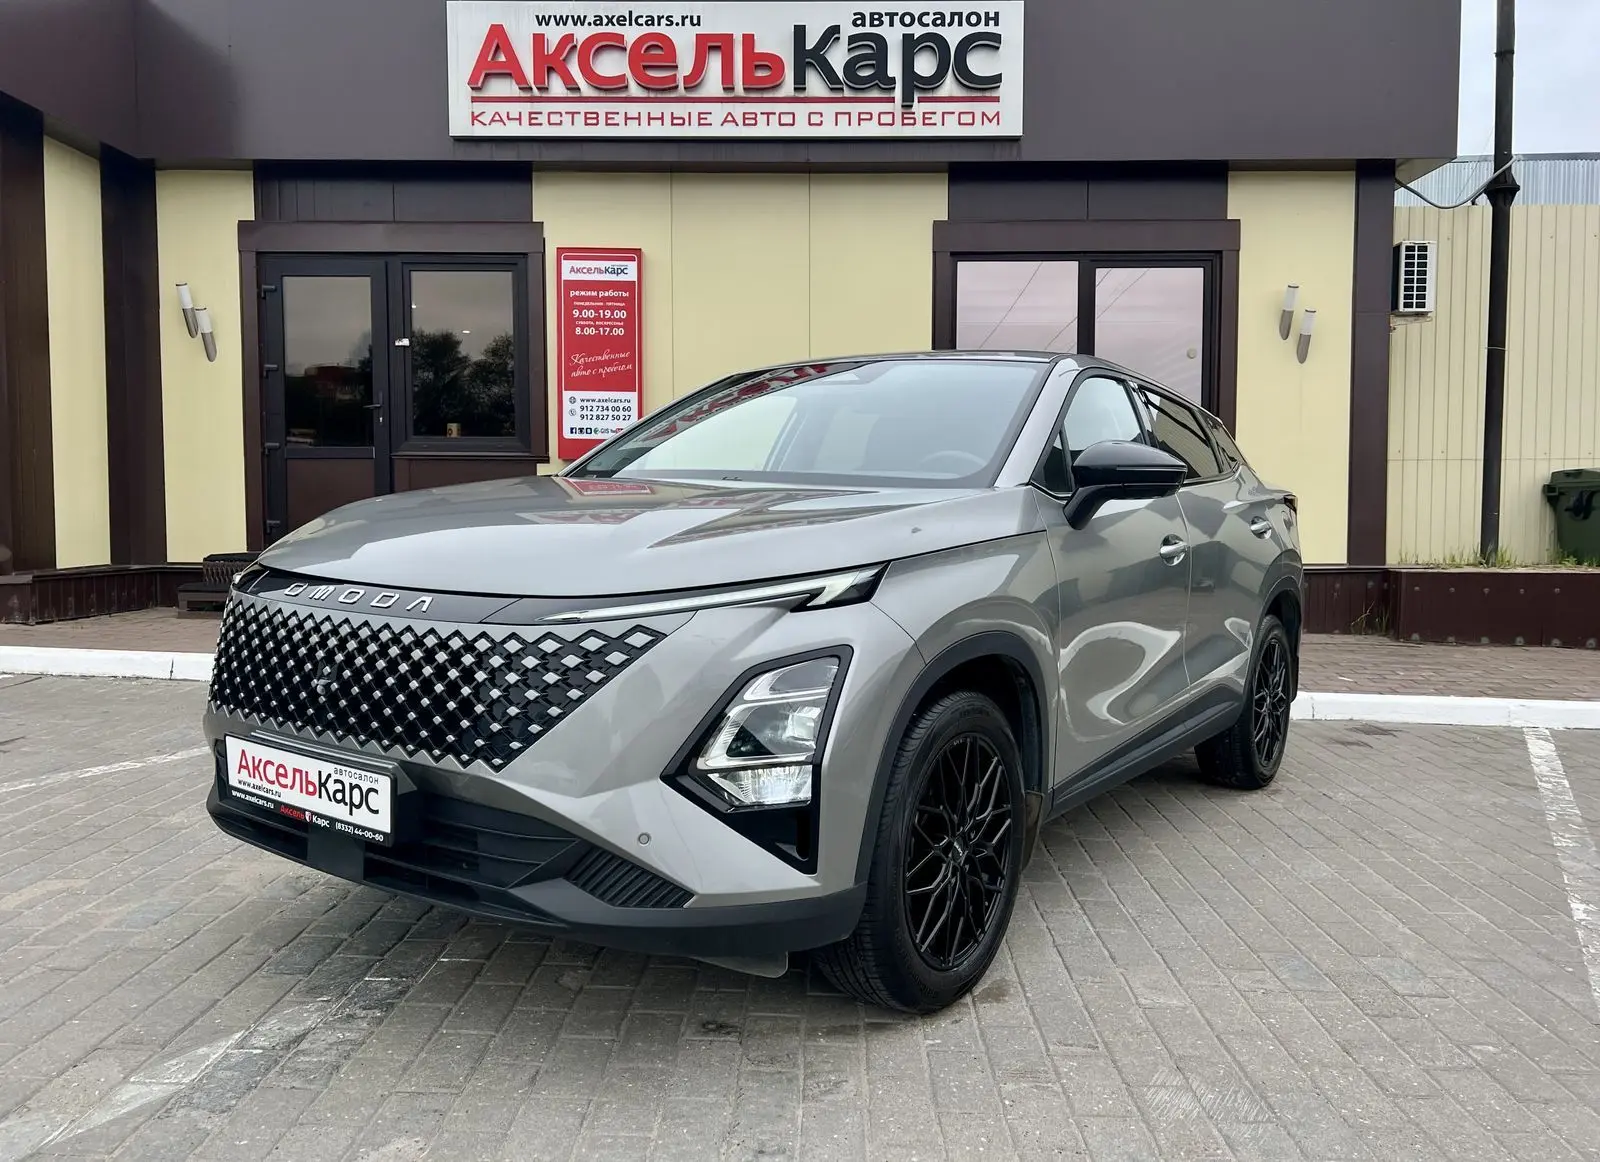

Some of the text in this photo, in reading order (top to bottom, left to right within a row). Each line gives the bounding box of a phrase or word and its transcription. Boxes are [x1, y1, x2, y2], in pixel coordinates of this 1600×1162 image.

[535, 10, 701, 27] www.axelcars.ru
[851, 11, 1000, 28] автосалон
[467, 23, 1003, 109] АксельКарс
[470, 111, 1001, 127] КАЧЕСТВЕННЫЕ АВТО С ПРОБЕГОМ
[569, 266, 628, 276] АксельКарс
[570, 290, 629, 298] режим работы
[572, 309, 627, 319] 9.00-19.00
[575, 327, 625, 336] 8.00-17.00
[284, 582, 434, 613] OMODA
[237, 749, 380, 816] АксельКарс
[333, 766, 379, 785] автосалон
[237, 778, 282, 798] www.axelcars.ru
[231, 789, 275, 809] www.axelcars.ru
[312, 815, 330, 828] Карс
[335, 821, 384, 842] (8332) 44-00-60
